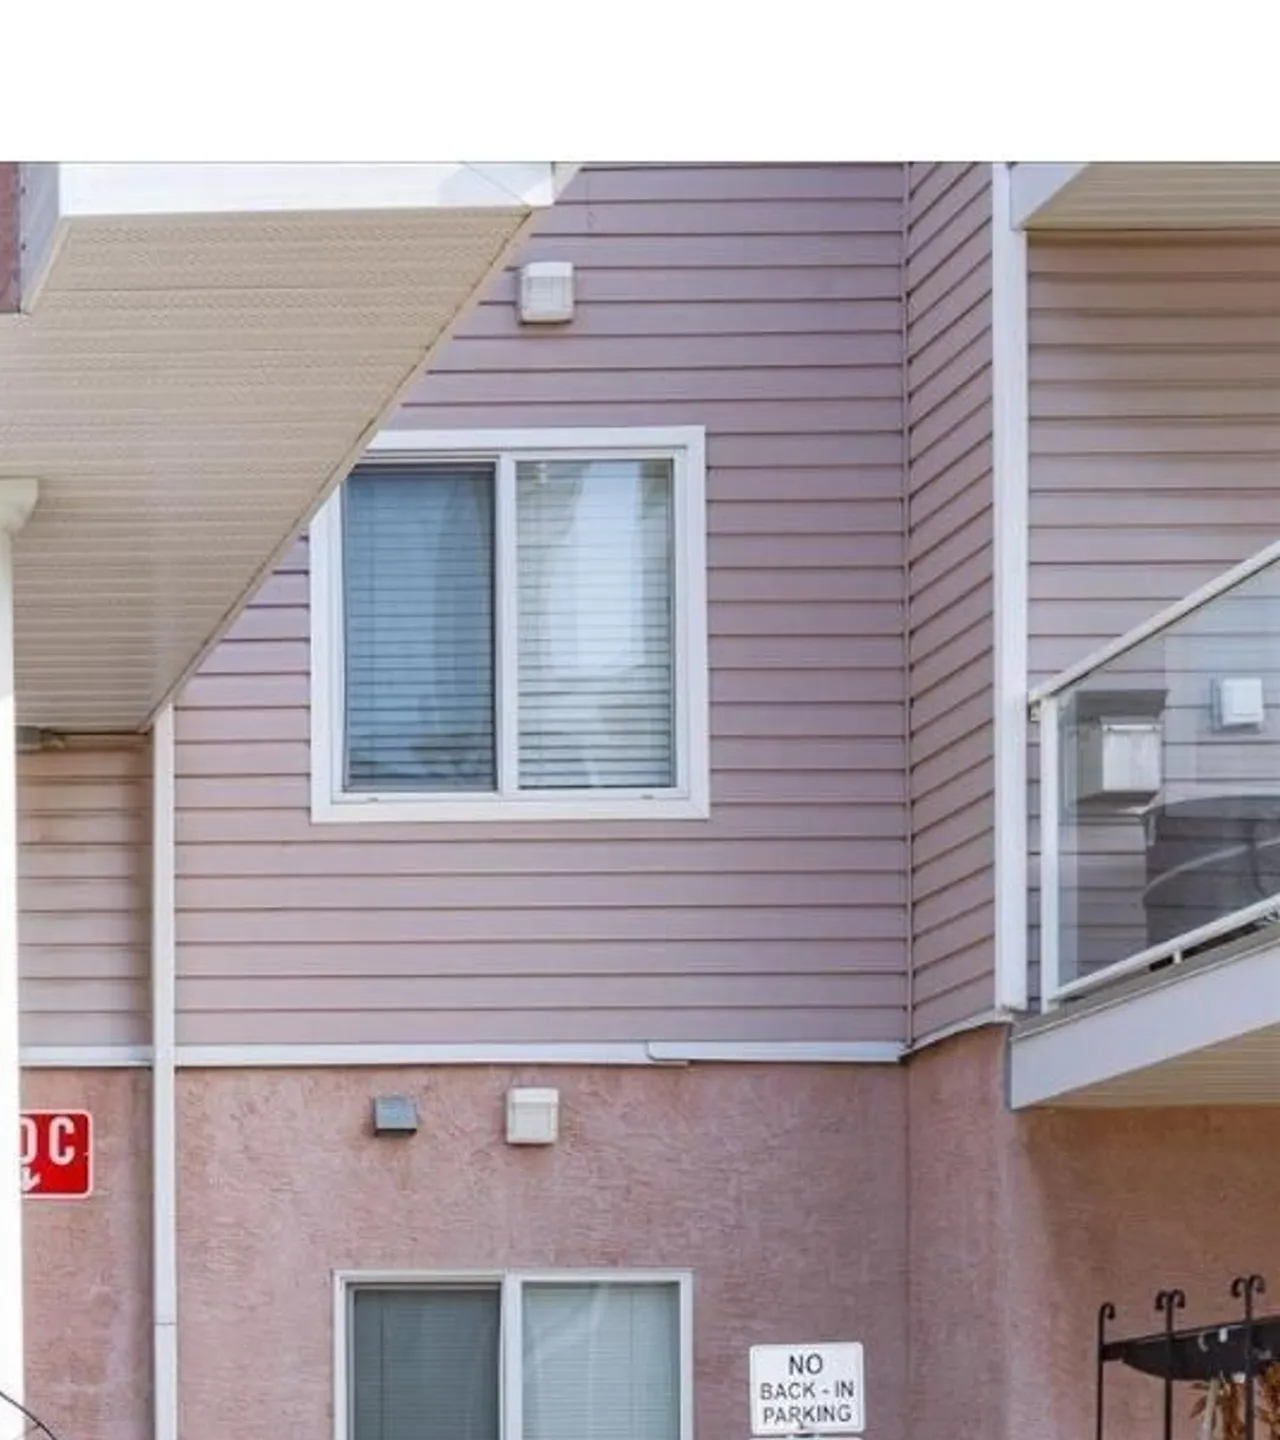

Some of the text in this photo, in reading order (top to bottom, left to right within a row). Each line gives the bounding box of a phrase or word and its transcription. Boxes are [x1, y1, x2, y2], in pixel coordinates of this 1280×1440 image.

[788, 1354, 823, 1375] NO
[760, 1381, 816, 1400] BACK
[835, 1380, 854, 1398] IN
[763, 1404, 852, 1424] PARKING
